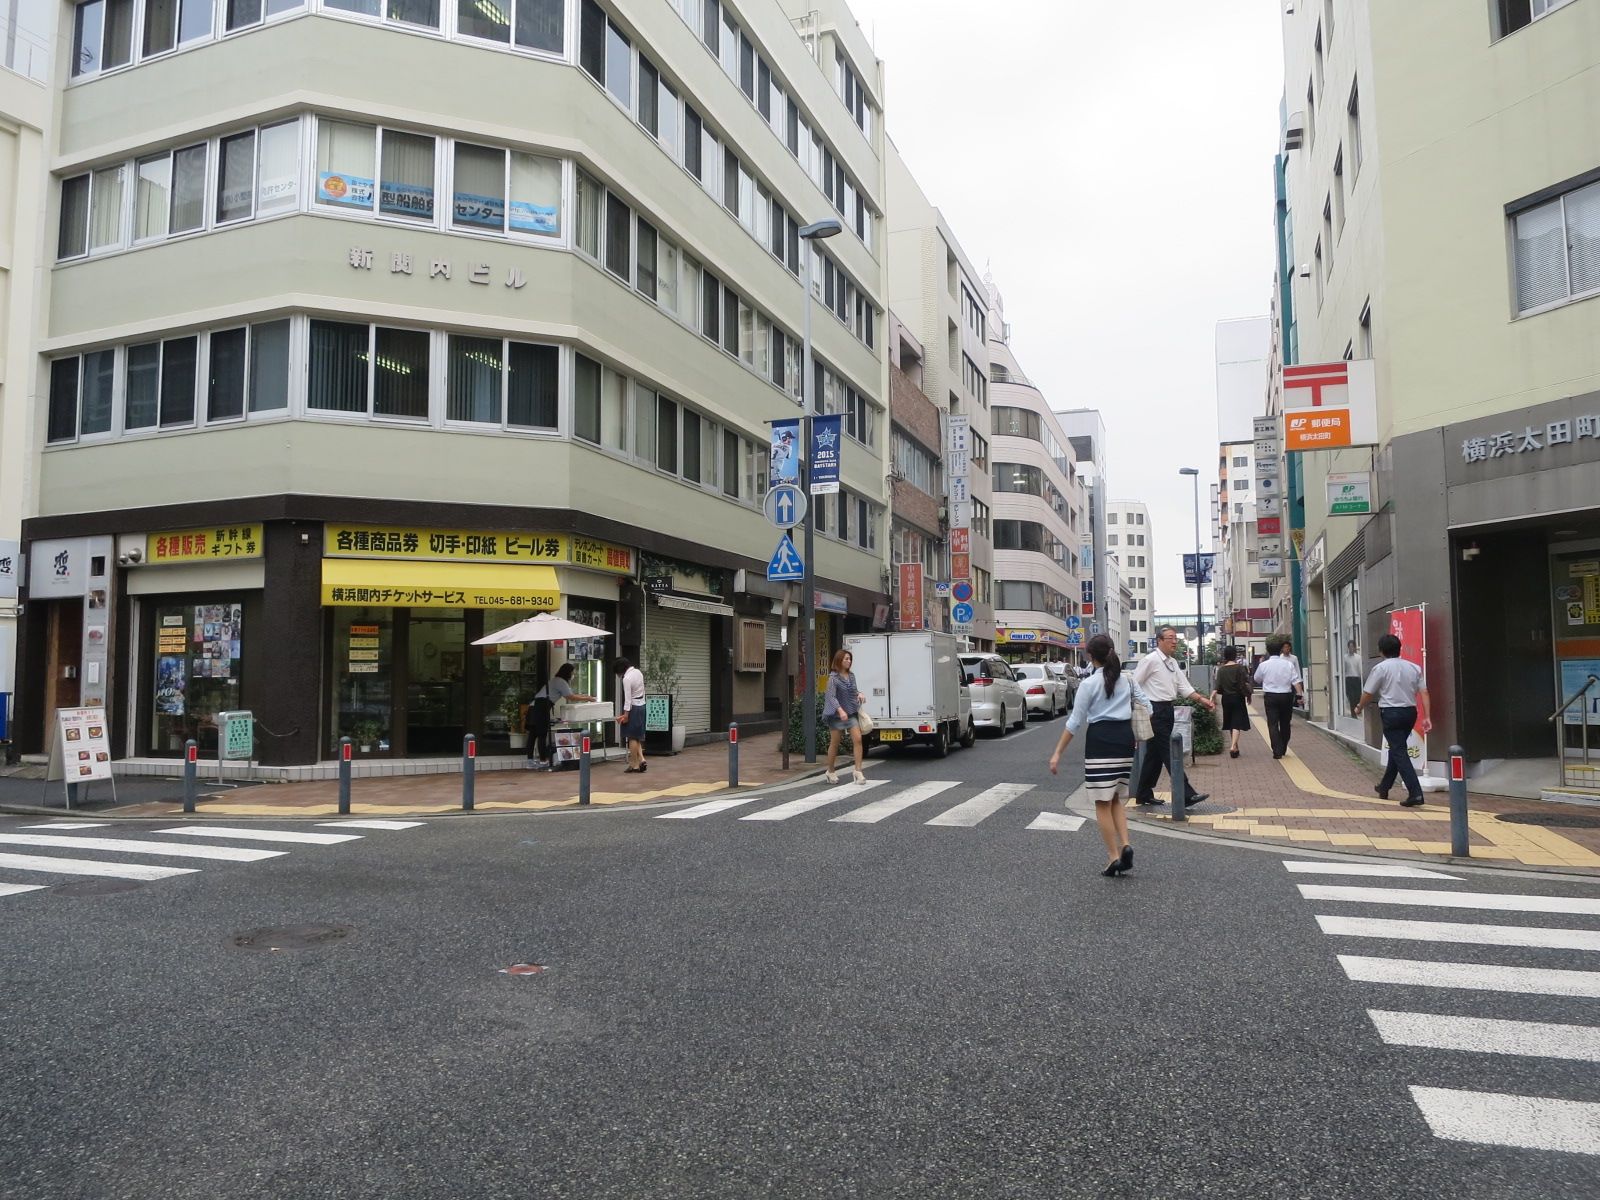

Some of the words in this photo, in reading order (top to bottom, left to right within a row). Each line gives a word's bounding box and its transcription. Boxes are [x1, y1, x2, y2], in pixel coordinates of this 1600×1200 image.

[349, 245, 527, 289] 新関内ビル
[1311, 417, 1341, 428] 郵便局
[1461, 414, 1600, 463] 横浜太田町
[817, 450, 834, 459] 2015
[215, 528, 252, 542] 新幹線
[336, 530, 418, 553] 各種商品券
[429, 533, 496, 555] 切手・印紙
[504, 536, 560, 557] ビール券
[156, 533, 206, 557] 各種販売
[211, 541, 256, 557] ギフト券
[332, 587, 466, 604] 横浜関内チケットサービス
[473, 595, 554, 606] TEL045-681-9340
